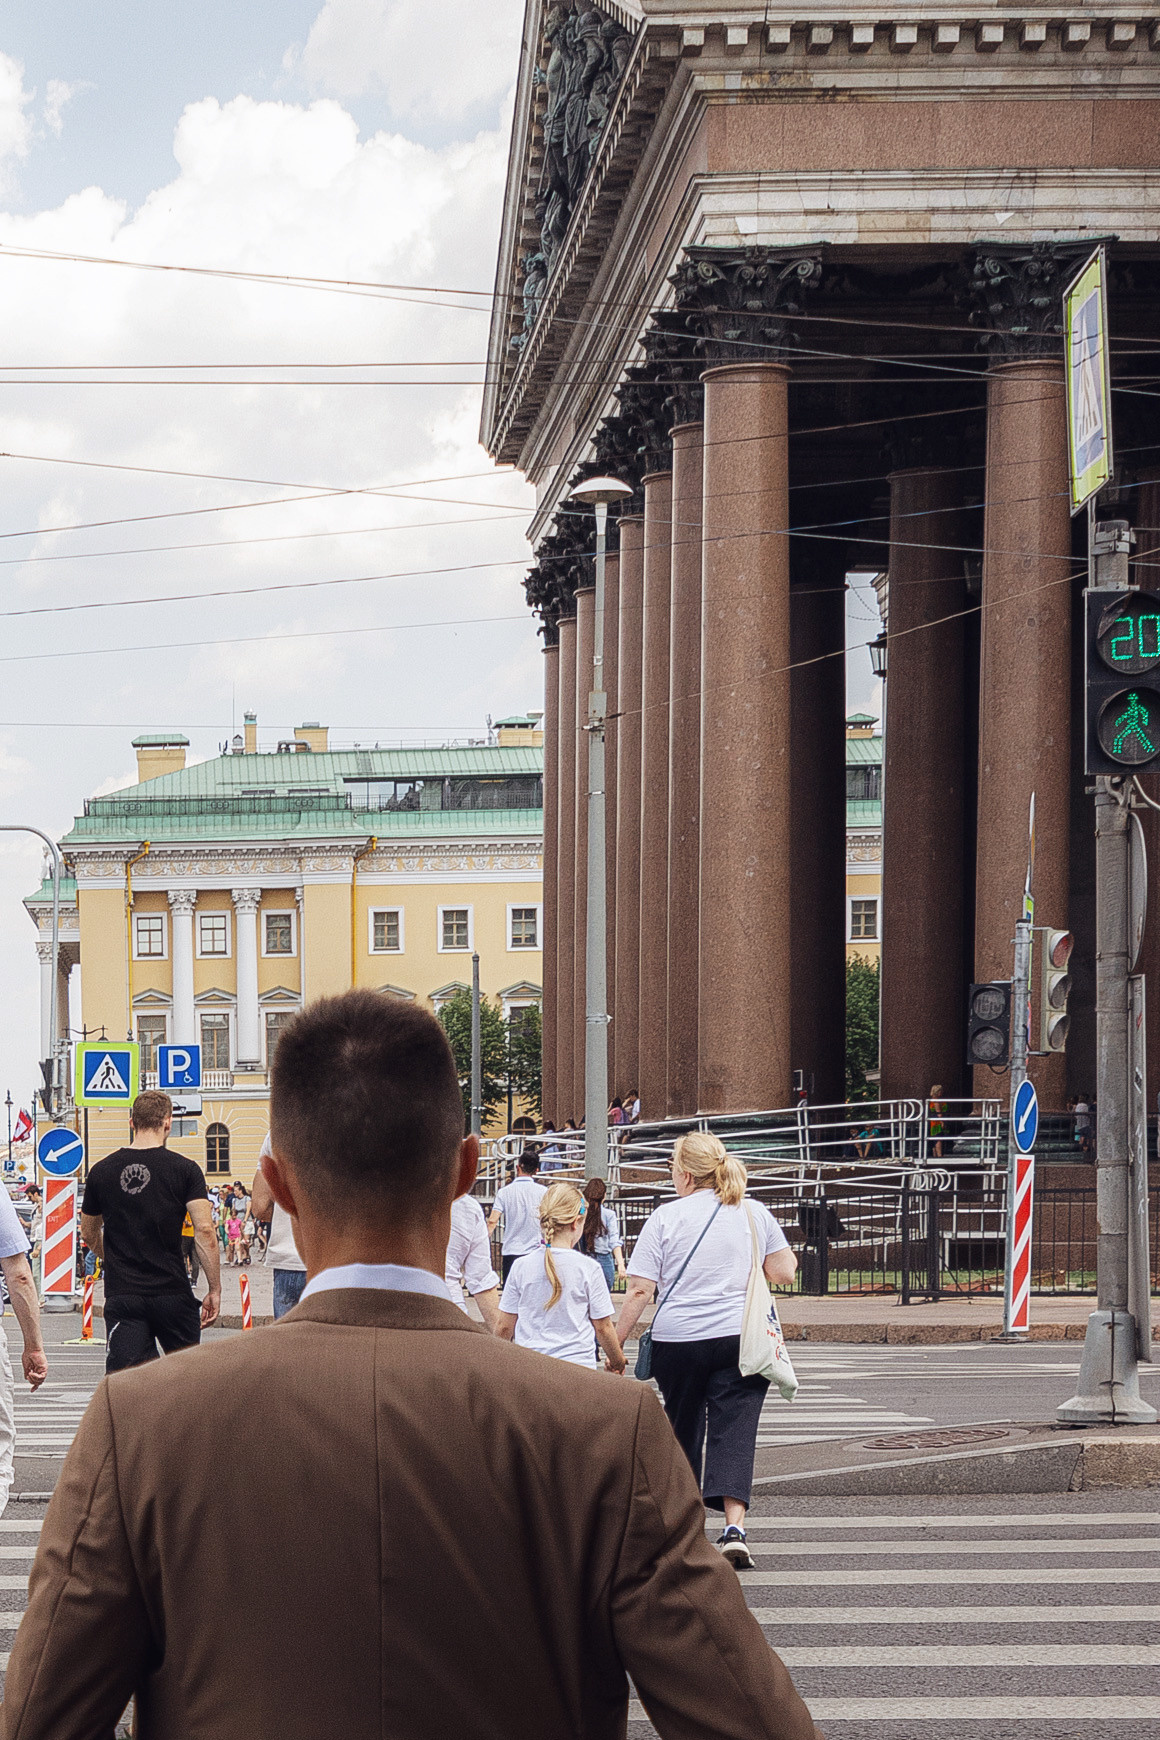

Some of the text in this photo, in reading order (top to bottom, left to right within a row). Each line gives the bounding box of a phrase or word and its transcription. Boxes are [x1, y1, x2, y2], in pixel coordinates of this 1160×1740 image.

[1111, 615, 1160, 660] 20
[167, 1049, 192, 1084] P
[6, 1161, 13, 1170] P
